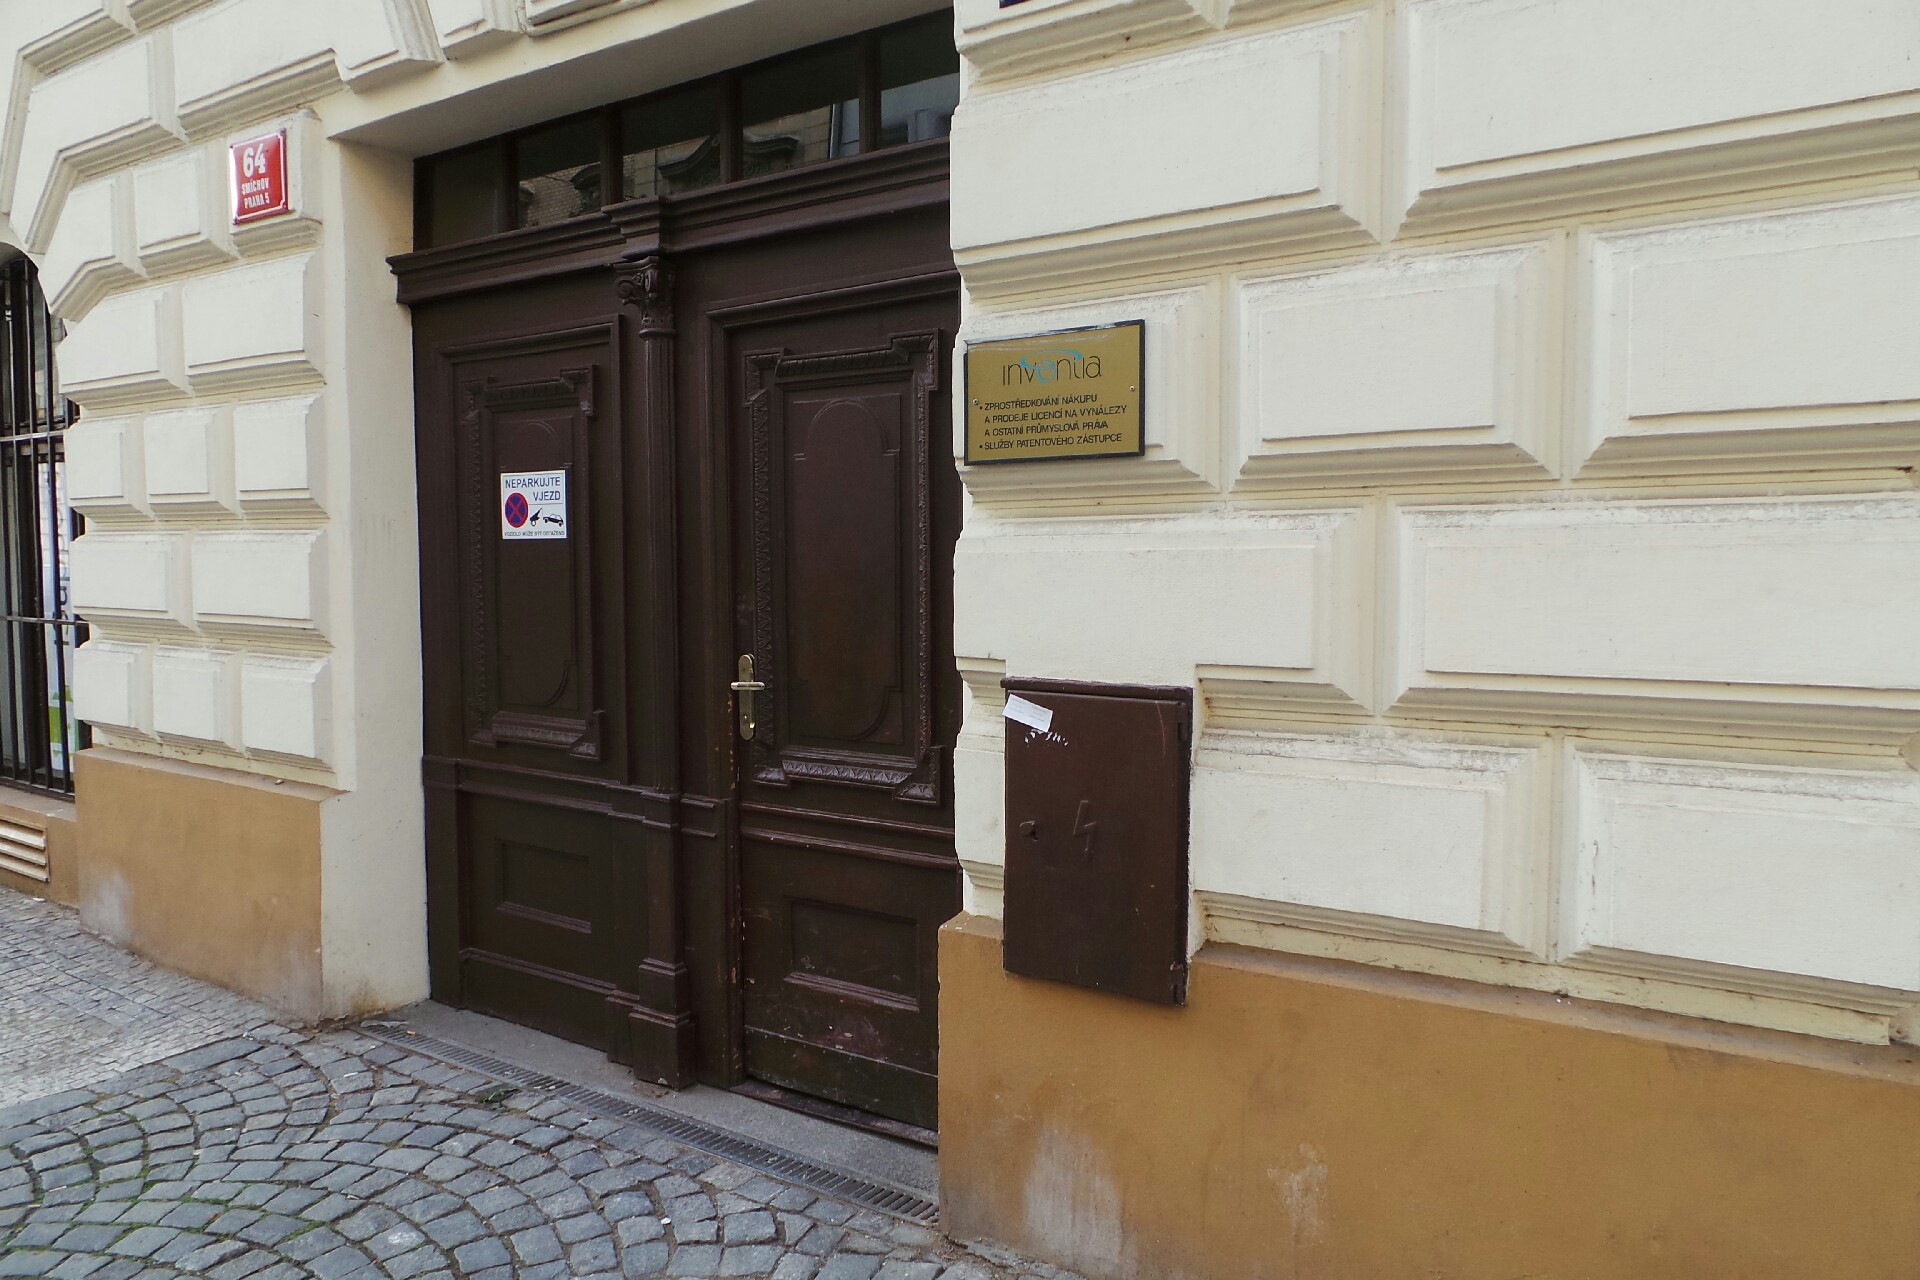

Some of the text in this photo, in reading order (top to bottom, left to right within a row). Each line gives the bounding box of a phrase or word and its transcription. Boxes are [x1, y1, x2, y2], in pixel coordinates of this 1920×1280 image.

[243, 143, 266, 178] 64
[242, 178, 269, 195] SMÍCHOV
[244, 192, 269, 208] PRAHA 5
[985, 394, 1097, 411] ZPROSTŘEDKOVÁNÍ NÁKUPU
[985, 405, 1127, 423] A PRODEJE LICENCÍ NA VYNÁLEZY
[985, 420, 1108, 436] A OSTATNÍ PRŮMYSLOVÁ PRÁVA
[985, 433, 1122, 450] SLUŽBY PATENTOVÉHO ZÁSTUPCE
[506, 477, 560, 488] NEPARKUJTE
[533, 491, 560, 501] VJEZD
